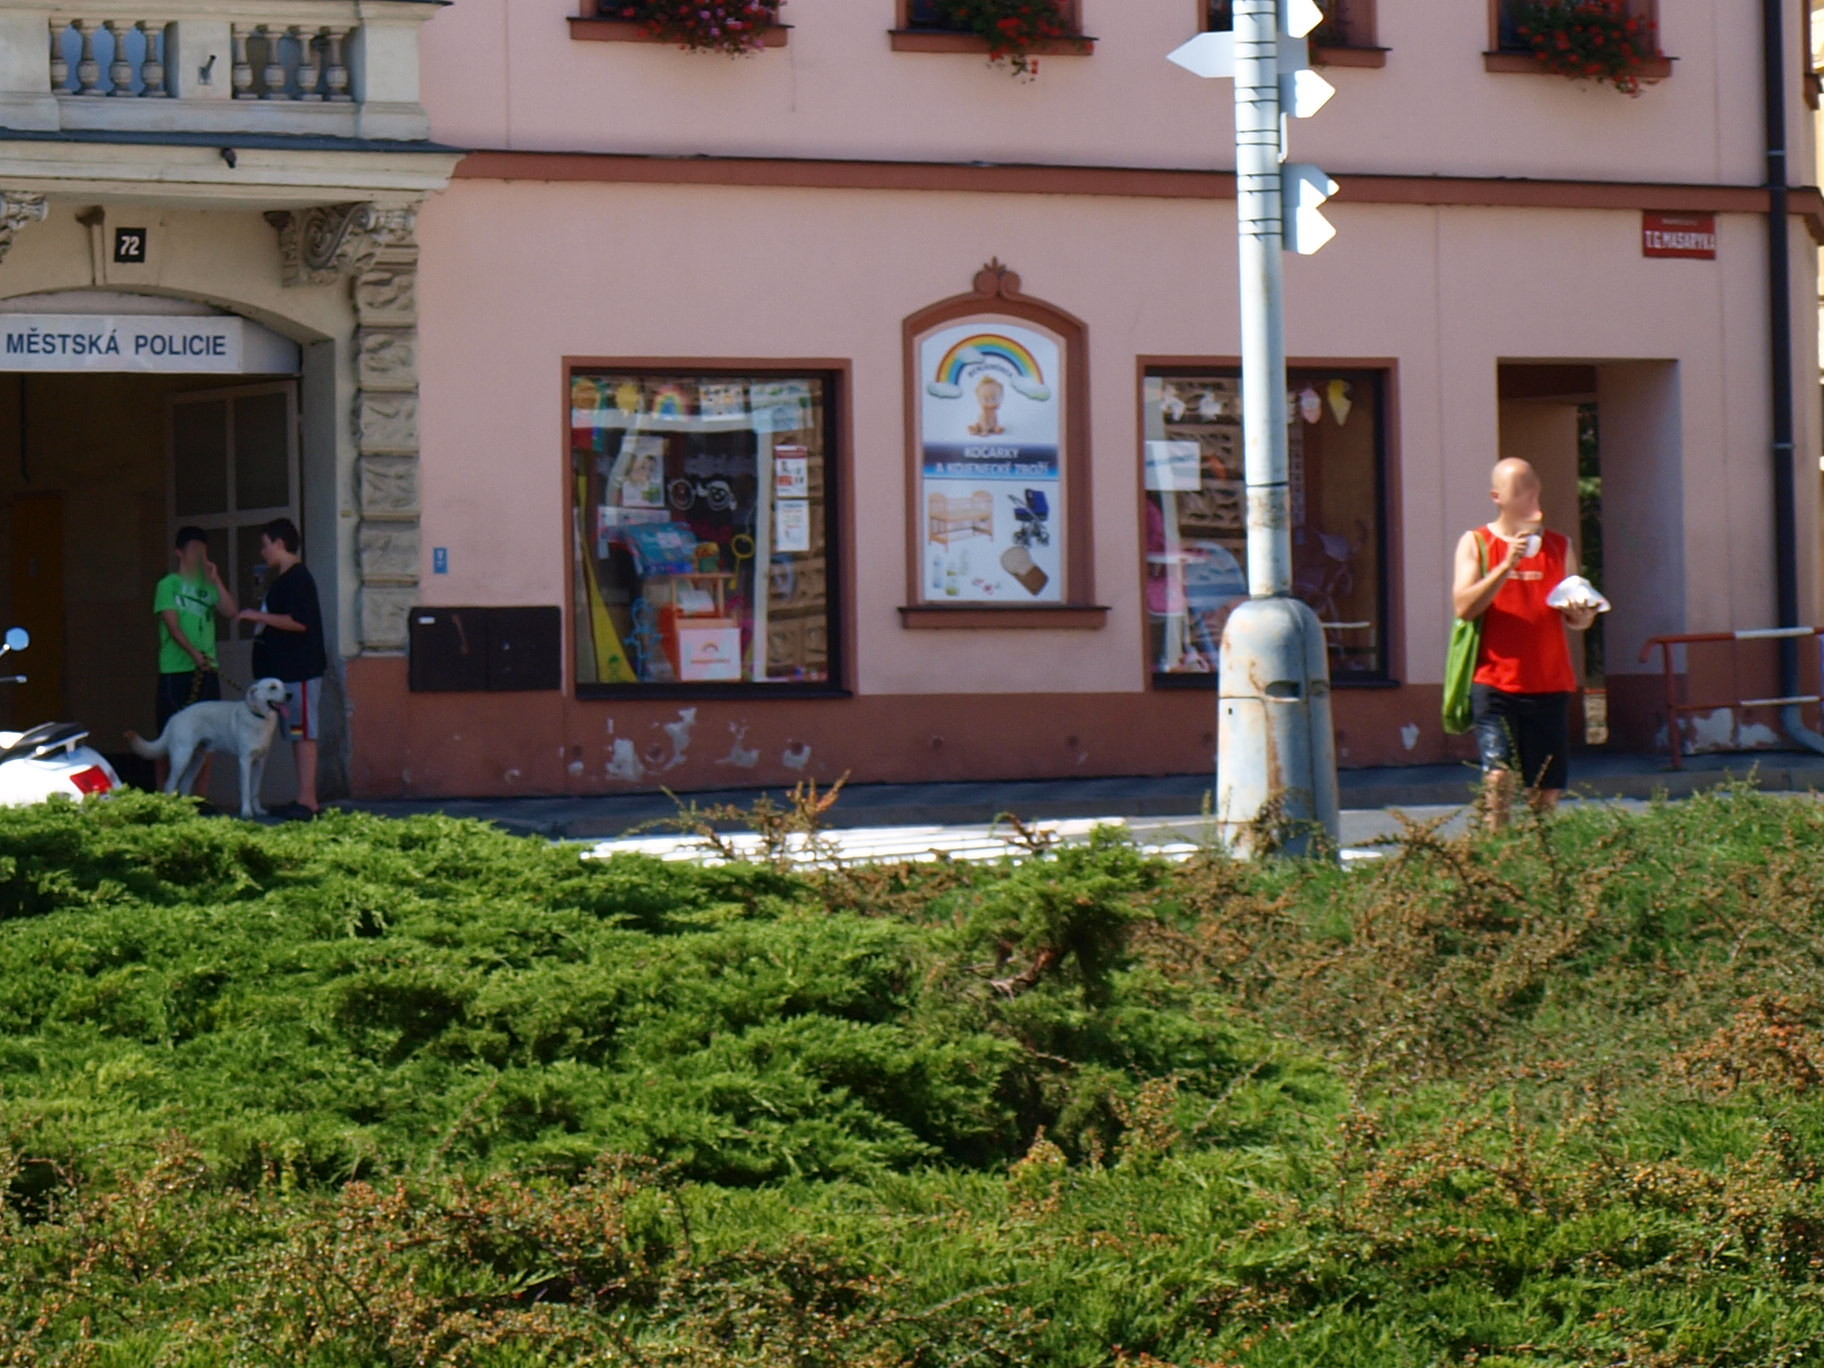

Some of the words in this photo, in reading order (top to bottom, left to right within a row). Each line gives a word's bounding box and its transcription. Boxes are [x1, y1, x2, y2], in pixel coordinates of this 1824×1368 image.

[120, 235, 140, 256] 72
[6, 328, 119, 355] MĚSTSKÁ
[134, 334, 226, 356] POLICIE
